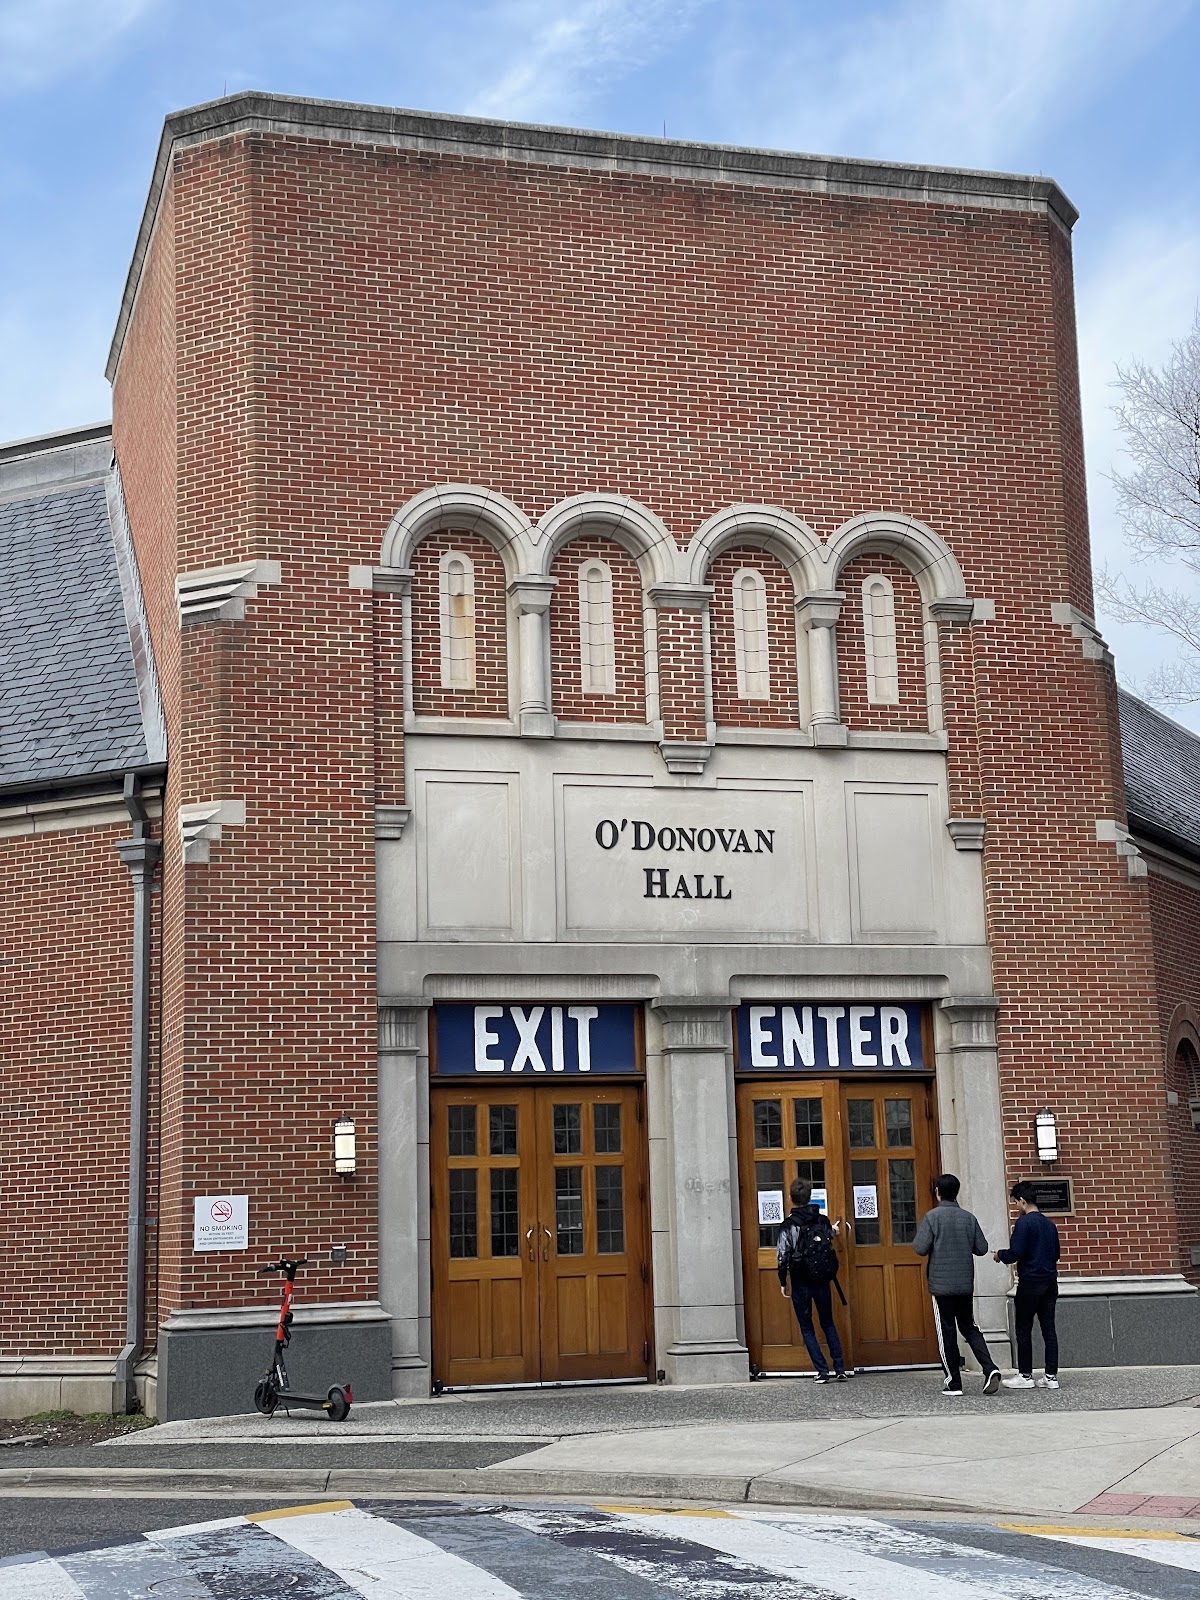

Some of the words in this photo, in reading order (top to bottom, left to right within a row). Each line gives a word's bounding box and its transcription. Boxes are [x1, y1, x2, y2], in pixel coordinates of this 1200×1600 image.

[595, 818, 776, 853] O'DONOVAN
[643, 868, 732, 899] HALL
[474, 1006, 598, 1072] EXIT
[749, 1006, 913, 1067] ENTER
